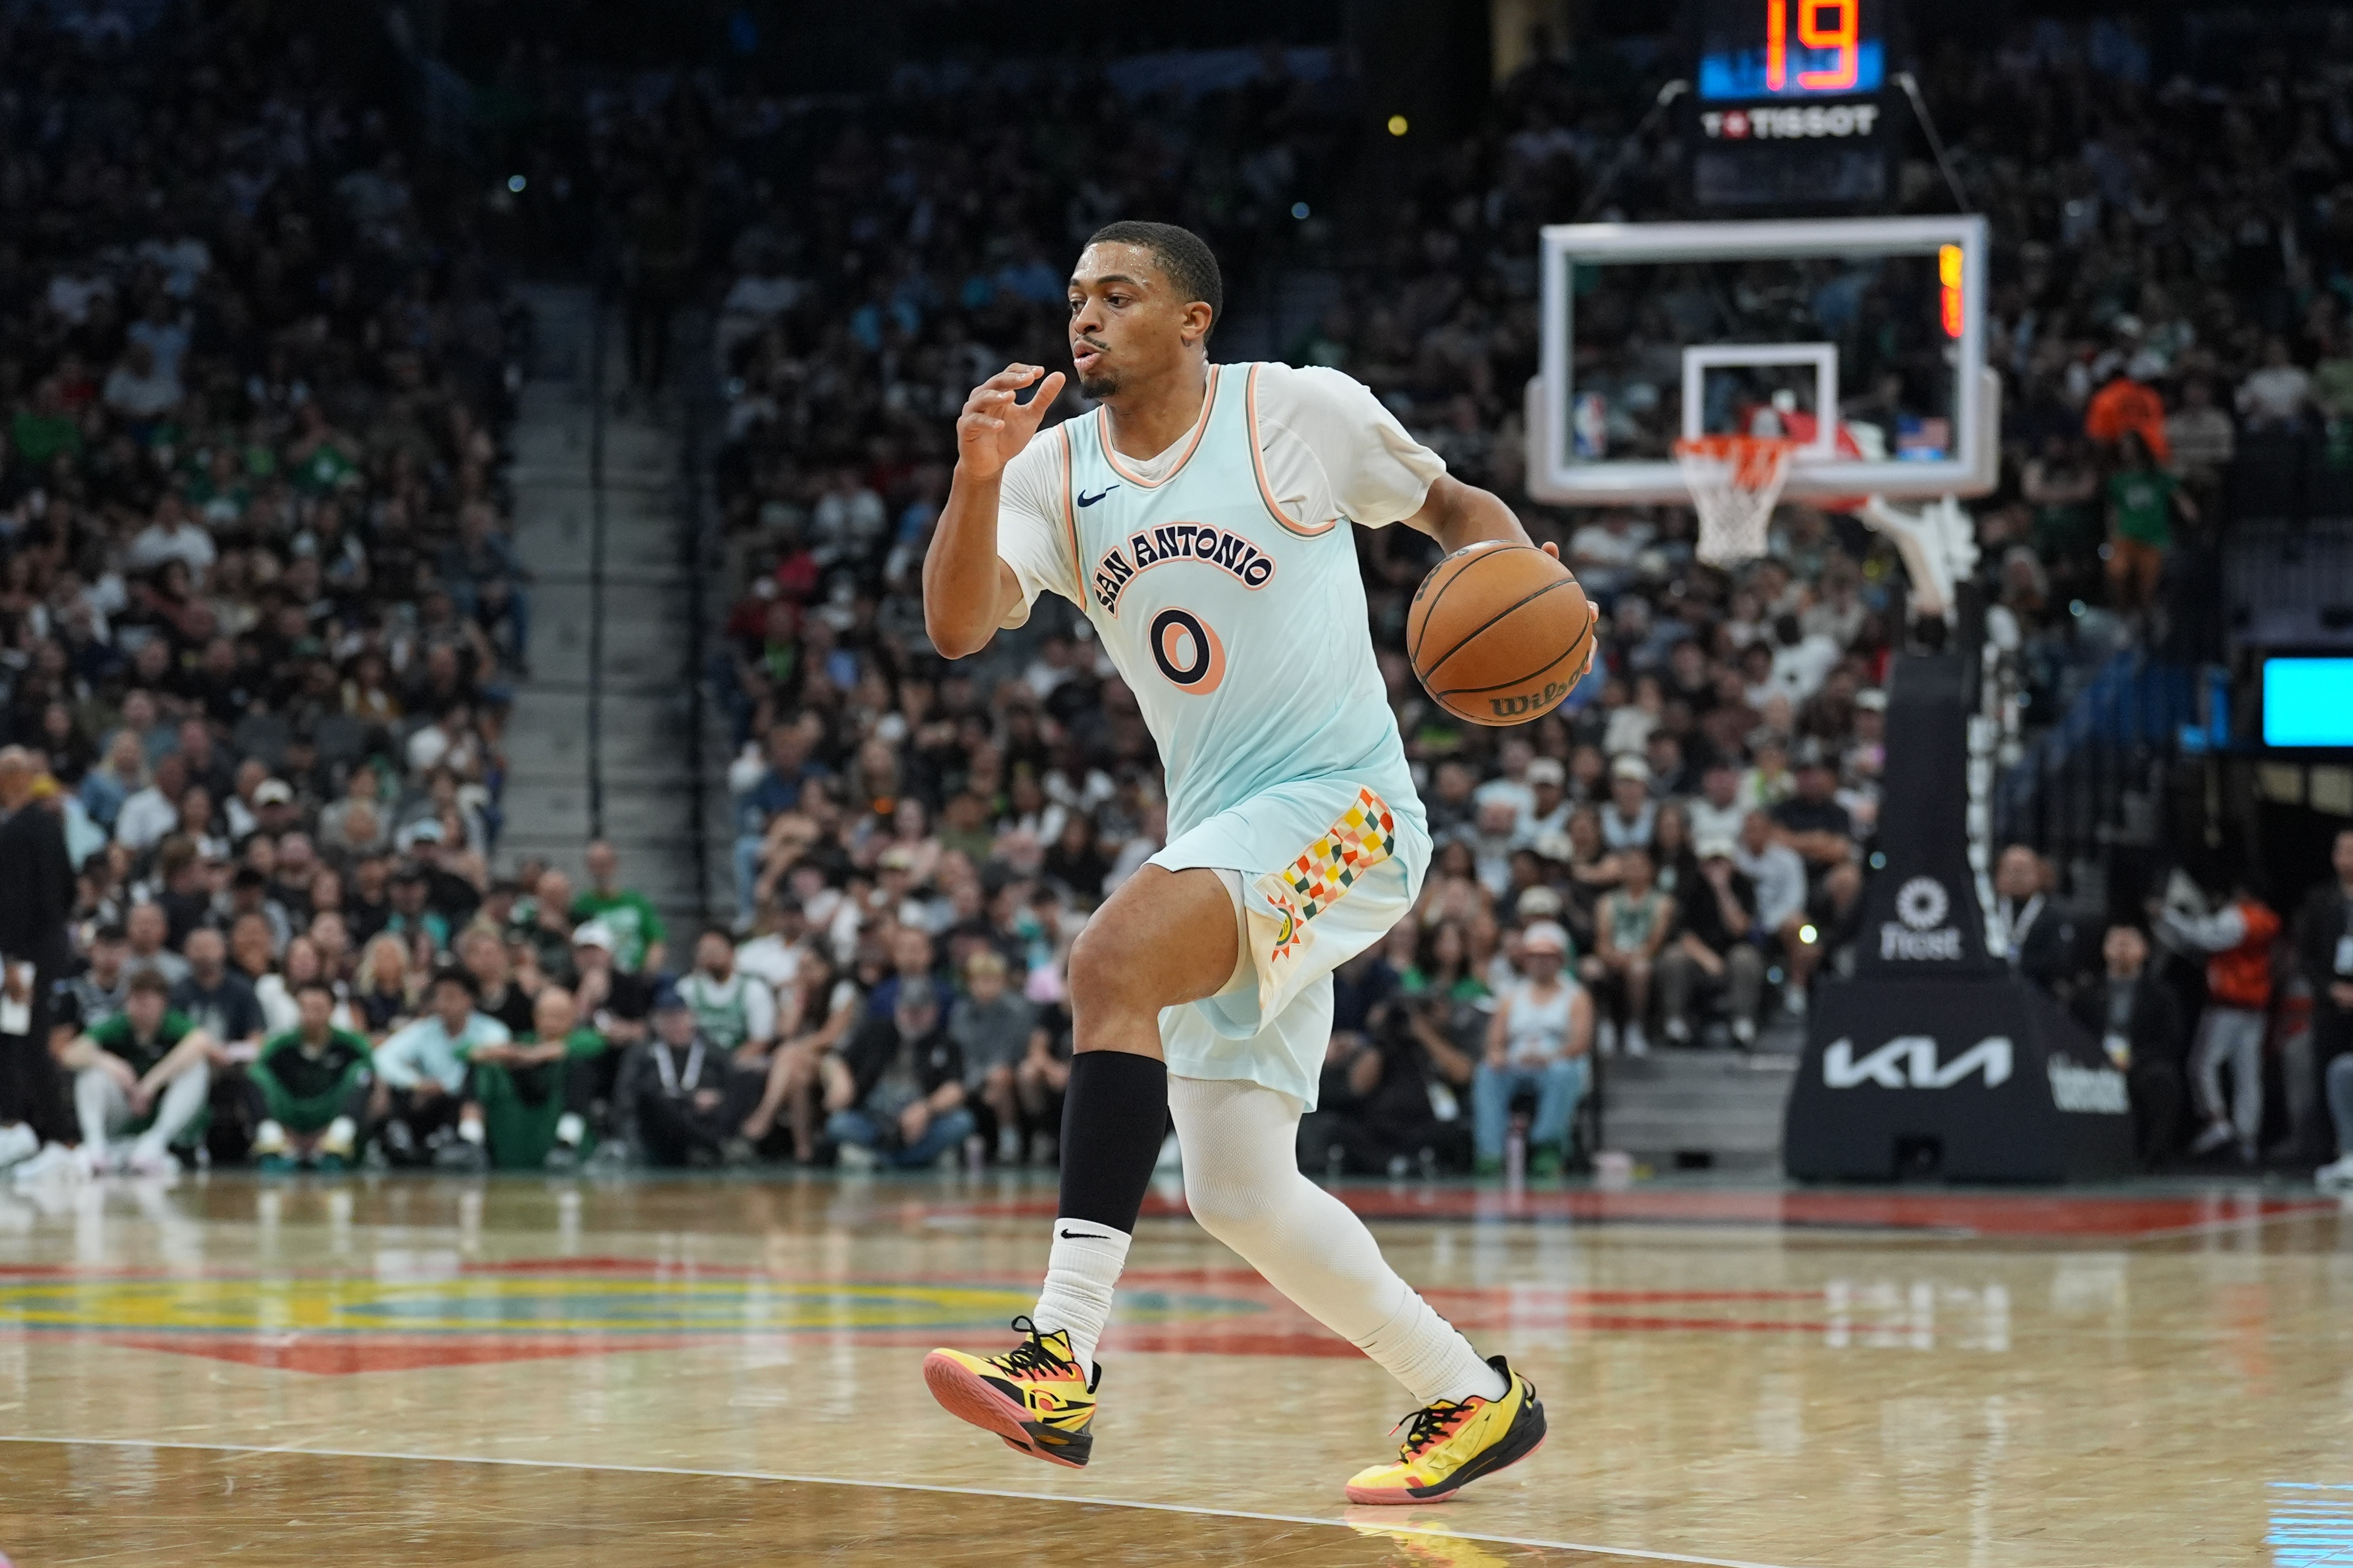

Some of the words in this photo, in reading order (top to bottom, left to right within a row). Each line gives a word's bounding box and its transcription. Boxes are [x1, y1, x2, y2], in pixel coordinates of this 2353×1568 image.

[1766, 0, 1859, 90] 19
[1750, 105, 1879, 139] TISSOT
[1093, 545, 1139, 619] SAN
[1128, 522, 1276, 590] ANTONIO
[1148, 606, 1215, 690] 0
[1823, 1035, 2013, 1089] KIA
